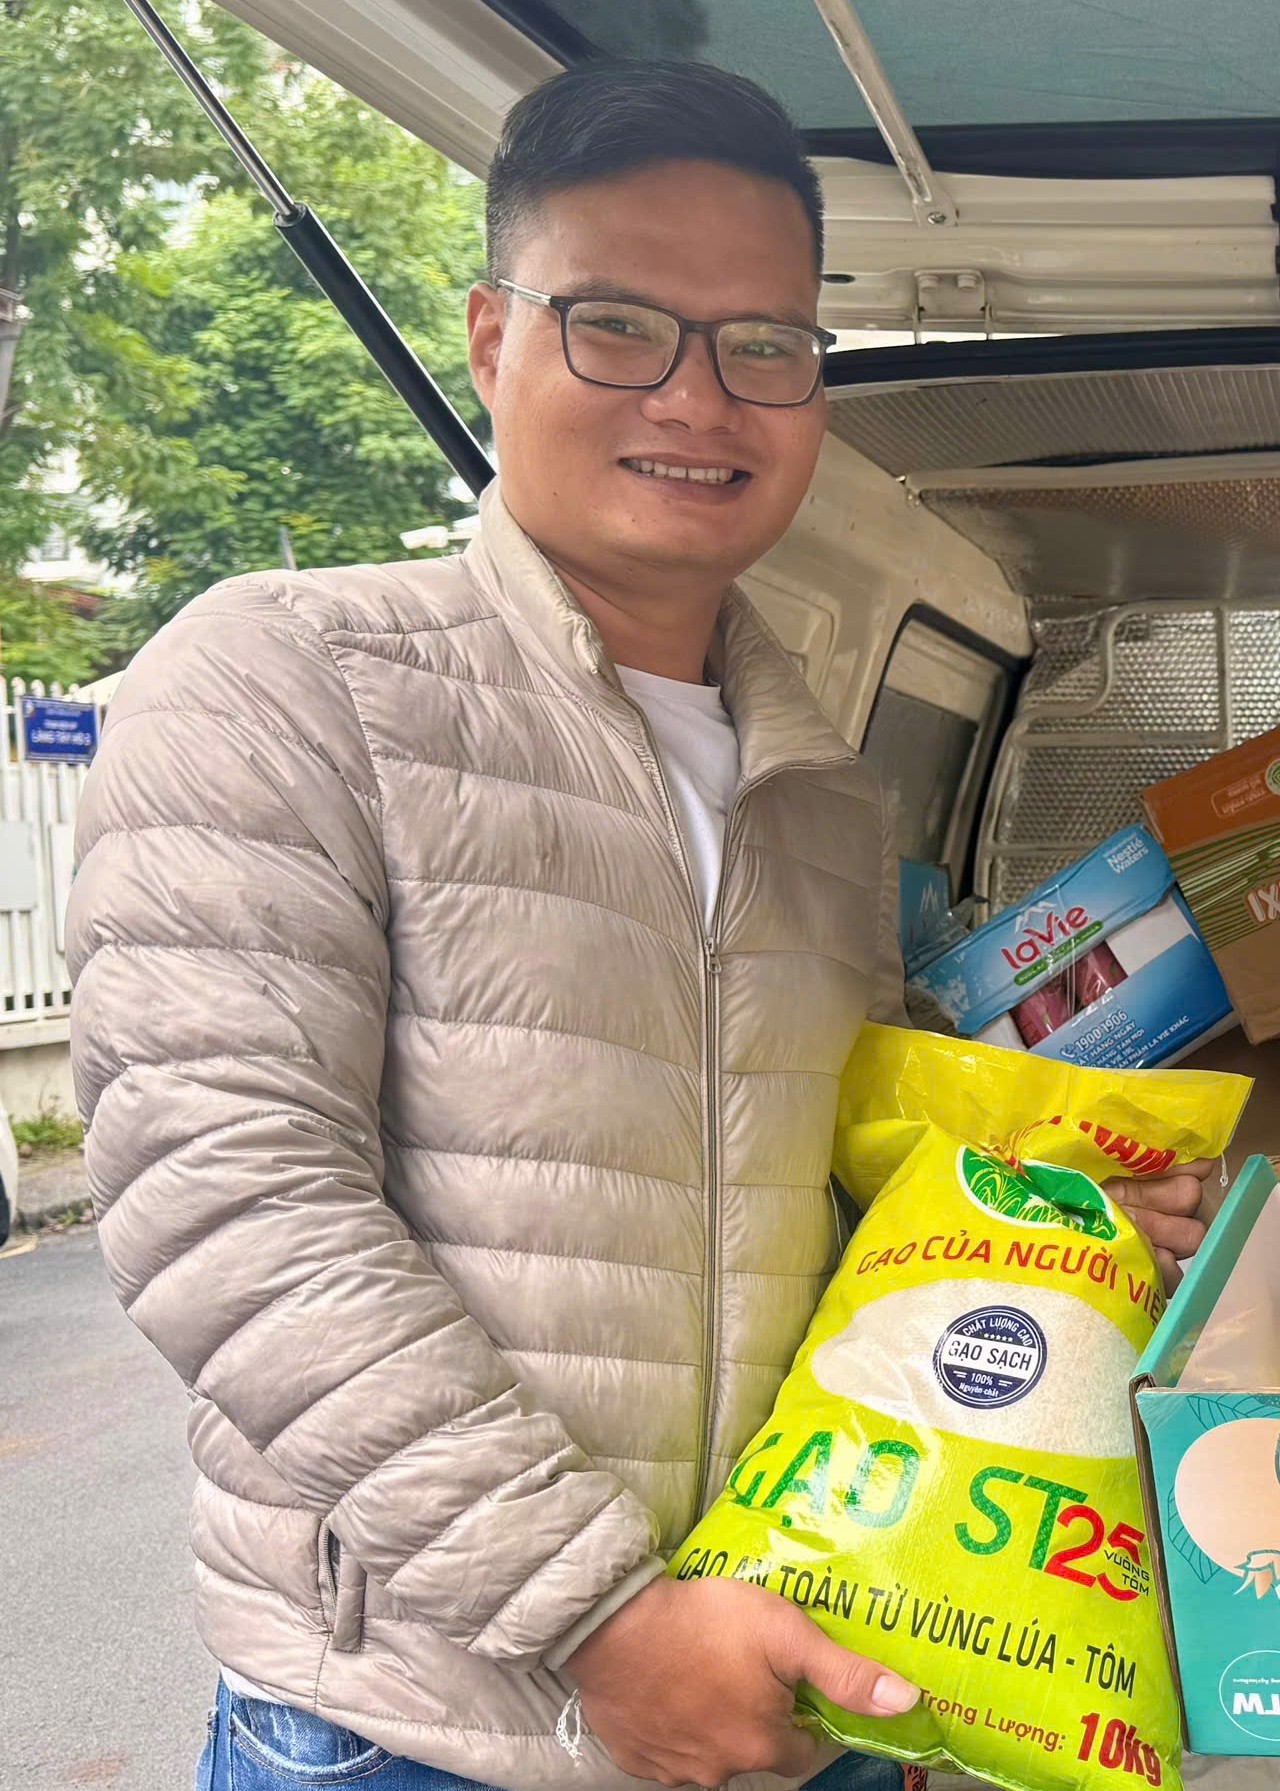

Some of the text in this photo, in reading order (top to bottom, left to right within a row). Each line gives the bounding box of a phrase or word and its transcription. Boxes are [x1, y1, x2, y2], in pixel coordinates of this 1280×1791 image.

[856, 1229, 1166, 1325] GẠO CỦA NGƯỜI VIỆ
[962, 1316, 1033, 1347] CHẤT LƯỢNG CAO
[948, 1340, 1032, 1371] GẠO SẠCH
[958, 1382, 983, 1394] Nguyên
[971, 1372, 993, 1386] 100%
[729, 1431, 1146, 1603] GẠO ST25
[1103, 1549, 1150, 1582] VUÔNG
[1121, 1573, 1150, 1597] TÔM
[779, 1565, 859, 1620] TOÀN
[865, 1582, 908, 1632] TỪ
[910, 1593, 995, 1656] VÙNG
[997, 1617, 1057, 1674] LÚA
[1084, 1642, 1137, 1699] TÔM
[919, 1687, 1067, 1753] Trọng Lượng:
[1077, 1711, 1162, 1788] 10kg
